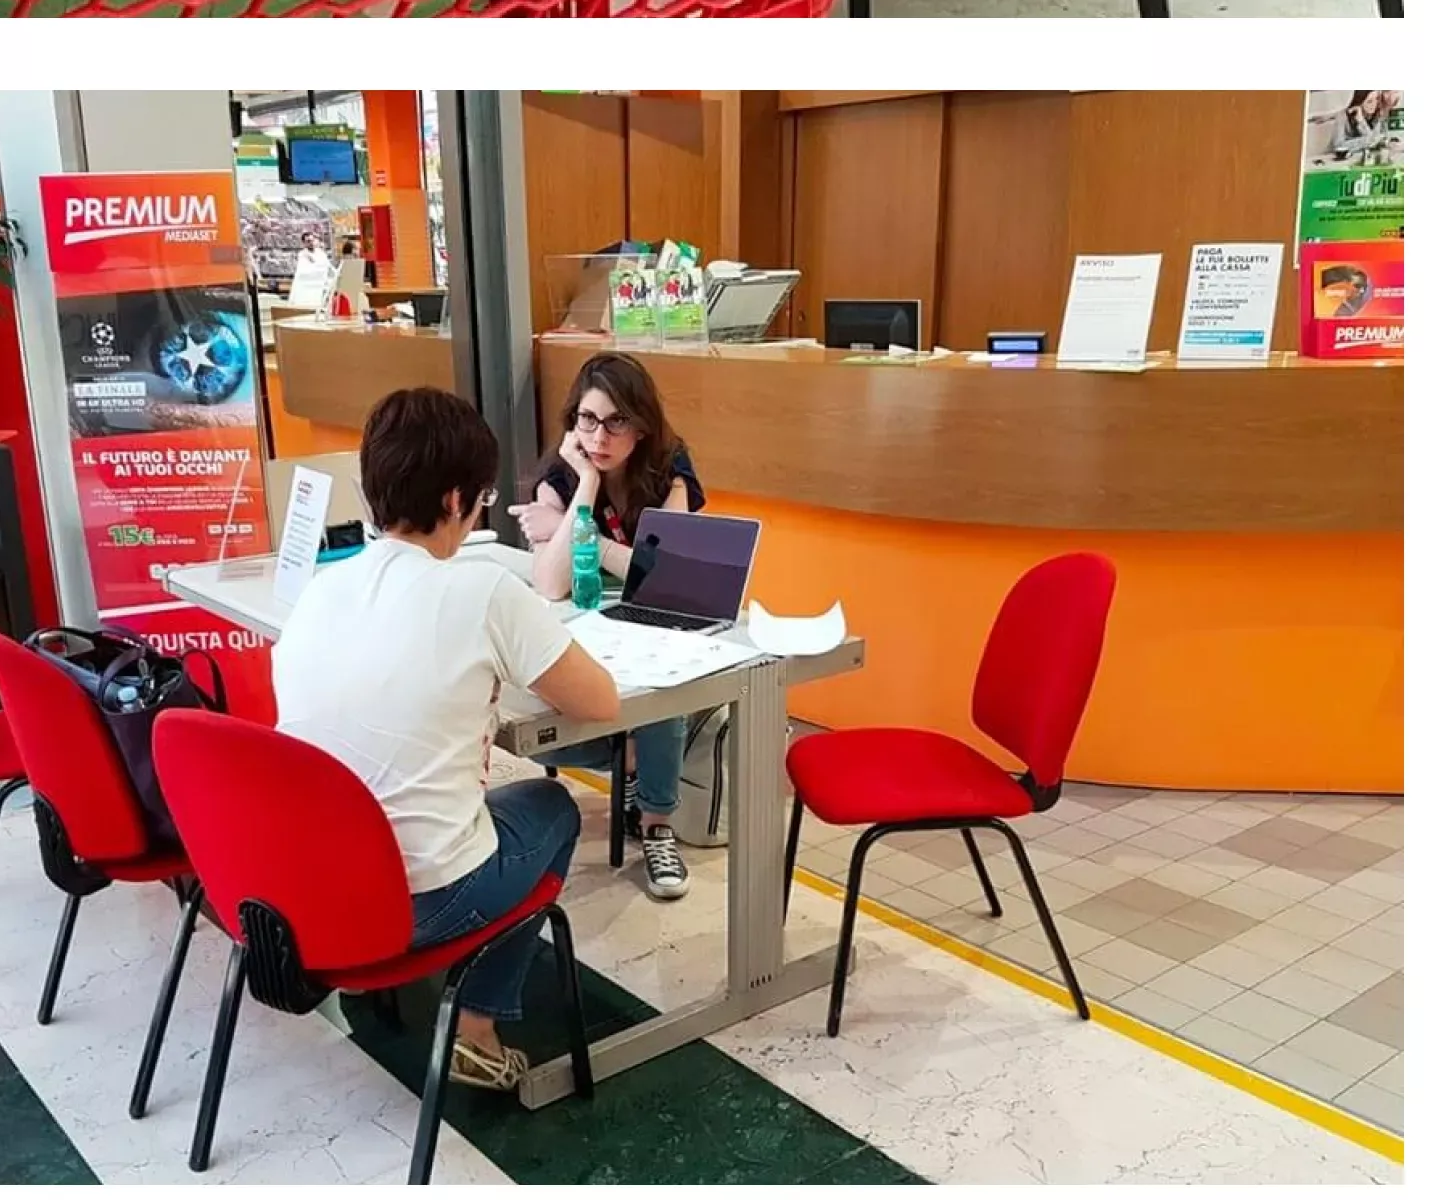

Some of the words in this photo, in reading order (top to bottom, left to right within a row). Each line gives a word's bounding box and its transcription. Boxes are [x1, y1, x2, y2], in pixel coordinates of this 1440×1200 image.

[64, 195, 218, 228] PREMIUM
[164, 228, 219, 242] MEDIASET
[1335, 326, 1404, 342] PREMIUM
[82, 451, 98, 465] IL
[100, 449, 162, 465] FUTURO
[167, 447, 177, 463] È
[180, 448, 251, 463] DAVANTI
[114, 464, 131, 477] AI
[135, 463, 172, 476] TUOI
[175, 462, 223, 475] OCCHI
[108, 524, 155, 547] 15€
[140, 632, 224, 653] QUISTA
